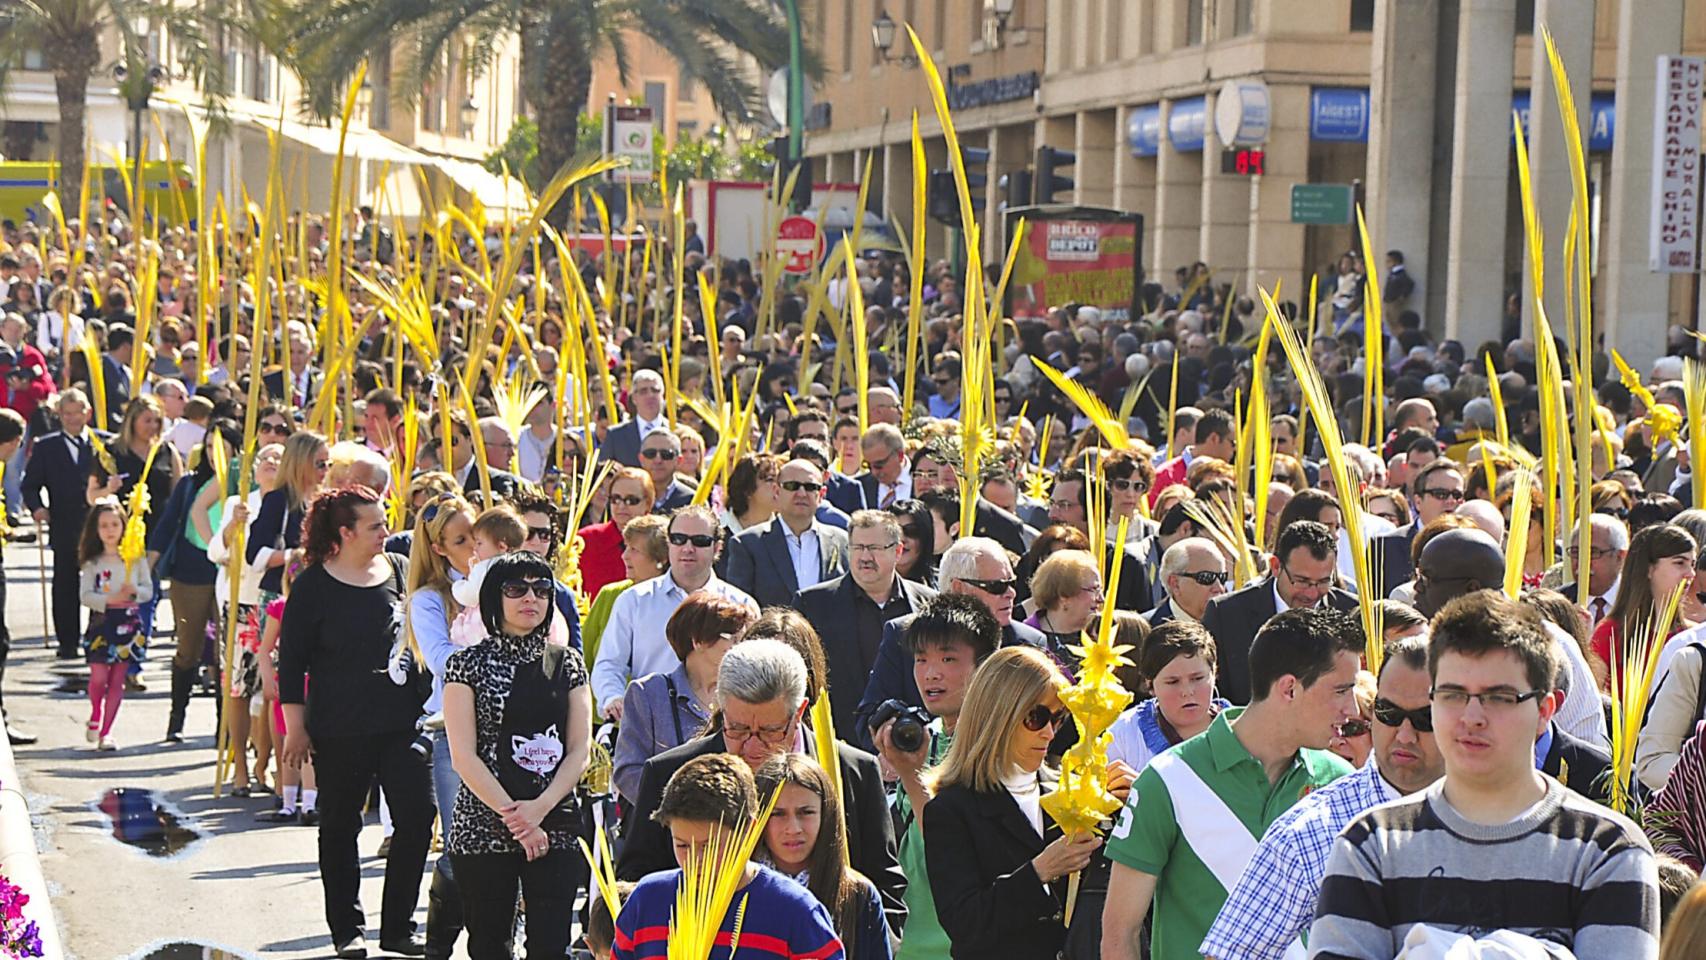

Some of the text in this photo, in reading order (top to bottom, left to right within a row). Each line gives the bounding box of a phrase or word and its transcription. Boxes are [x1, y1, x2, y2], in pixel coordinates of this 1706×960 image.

[1684, 63, 1699, 129] NUEVA
[1663, 59, 1683, 244] RESTAURANTE CHINO
[1680, 147, 1697, 239] MURALLA
